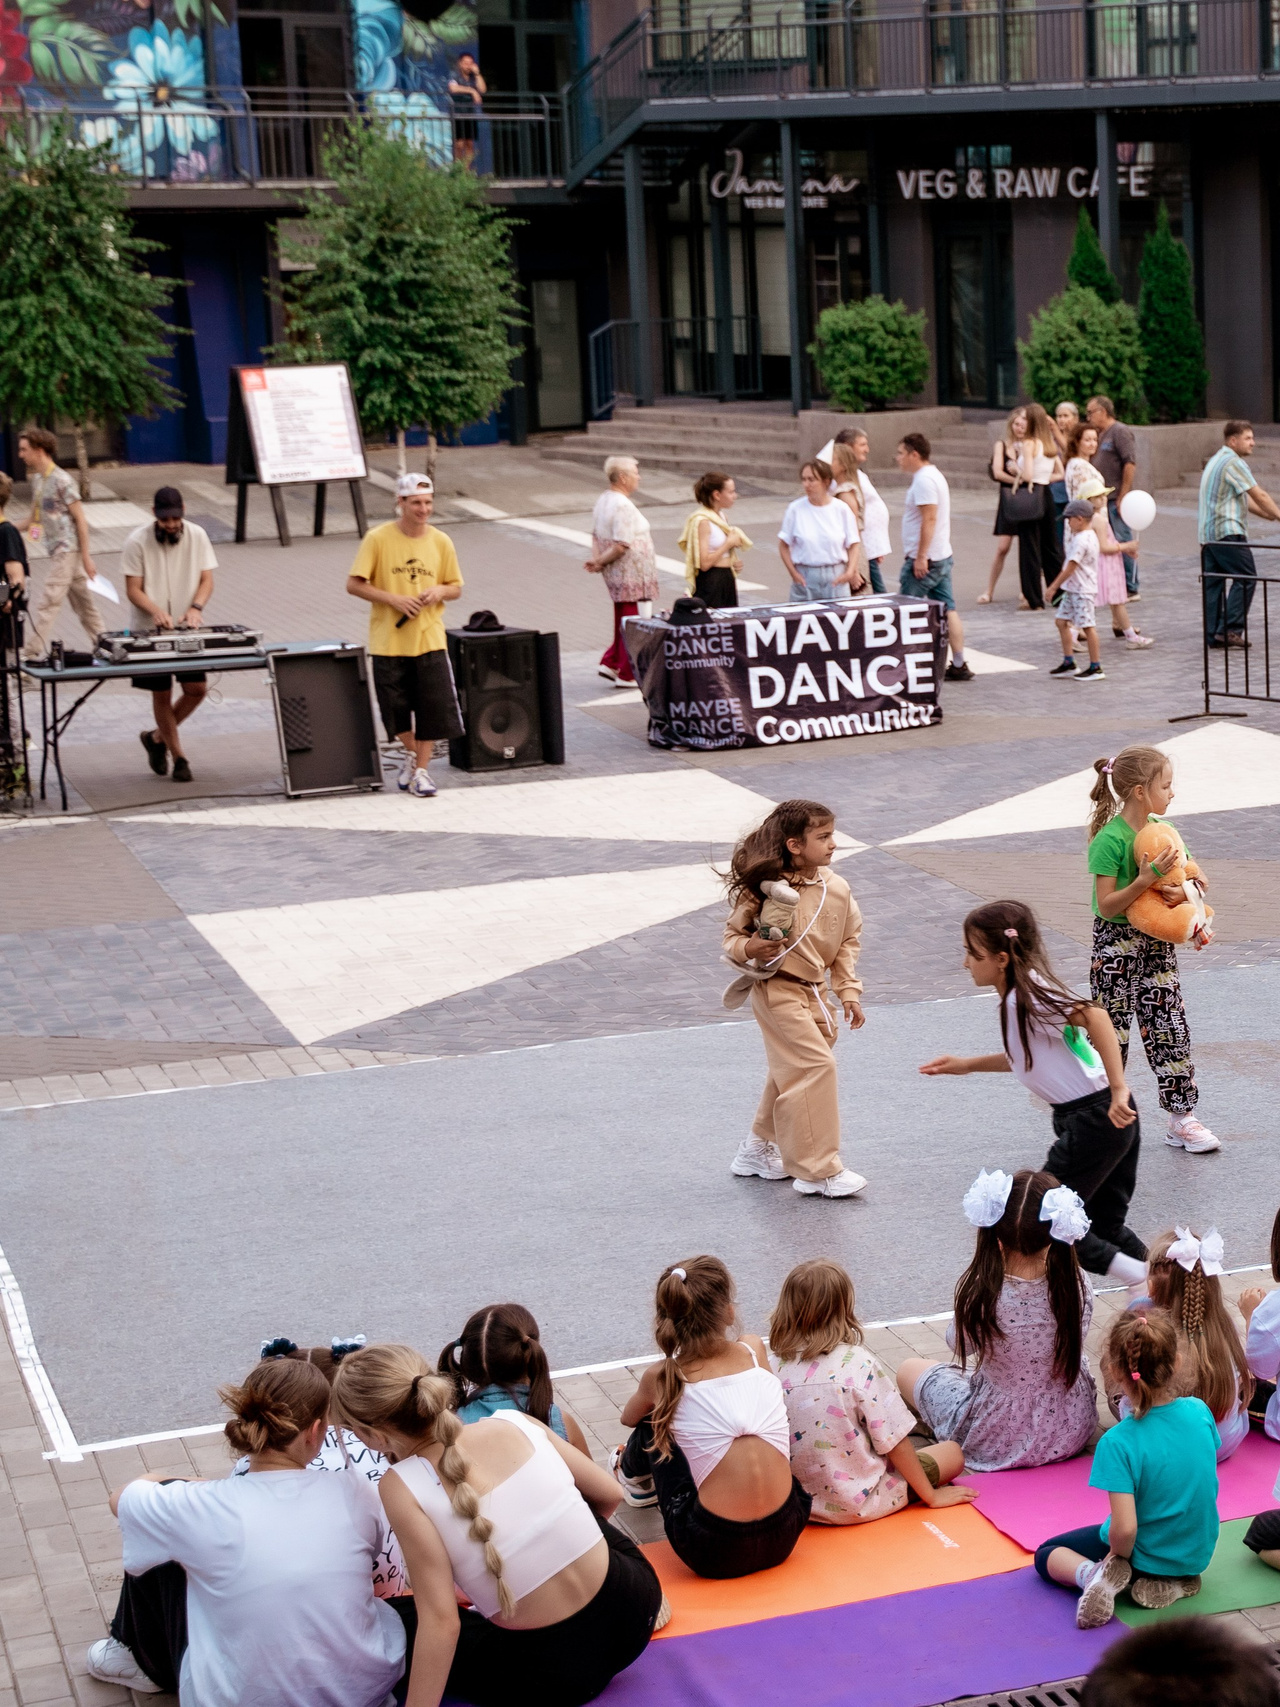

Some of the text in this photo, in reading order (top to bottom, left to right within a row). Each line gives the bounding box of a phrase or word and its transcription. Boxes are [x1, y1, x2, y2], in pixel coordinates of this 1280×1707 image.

[897, 169, 957, 199] VEG
[965, 168, 987, 199] &
[994, 167, 1060, 198] RAW
[744, 603, 934, 659] MAYBE
[664, 636, 734, 657] DANCE
[665, 654, 736, 670] Community
[748, 652, 935, 709] DANCE
[669, 697, 743, 718] MAYBE
[672, 716, 746, 735] DANCE
[755, 701, 935, 745] Community
